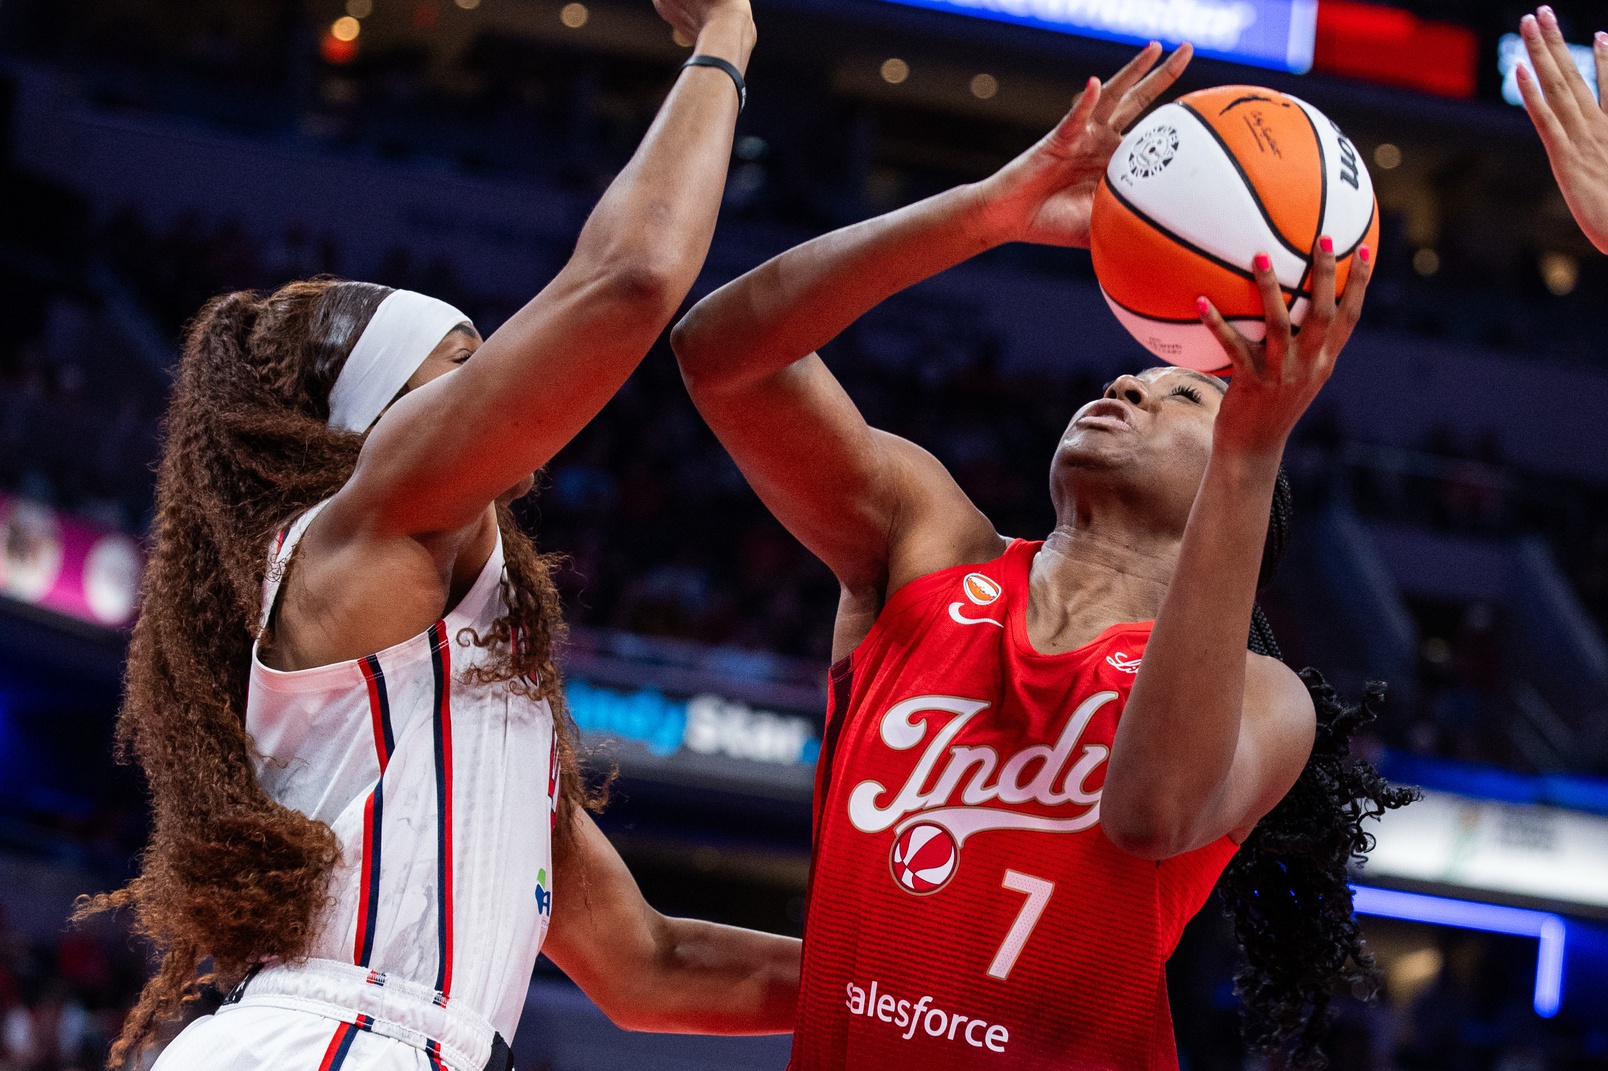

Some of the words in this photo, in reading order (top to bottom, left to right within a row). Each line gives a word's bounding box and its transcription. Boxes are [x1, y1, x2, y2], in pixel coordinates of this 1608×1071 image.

[848, 691, 1119, 834] Indi
[986, 868, 1056, 980] 7
[845, 980, 1009, 1053] salesforce
